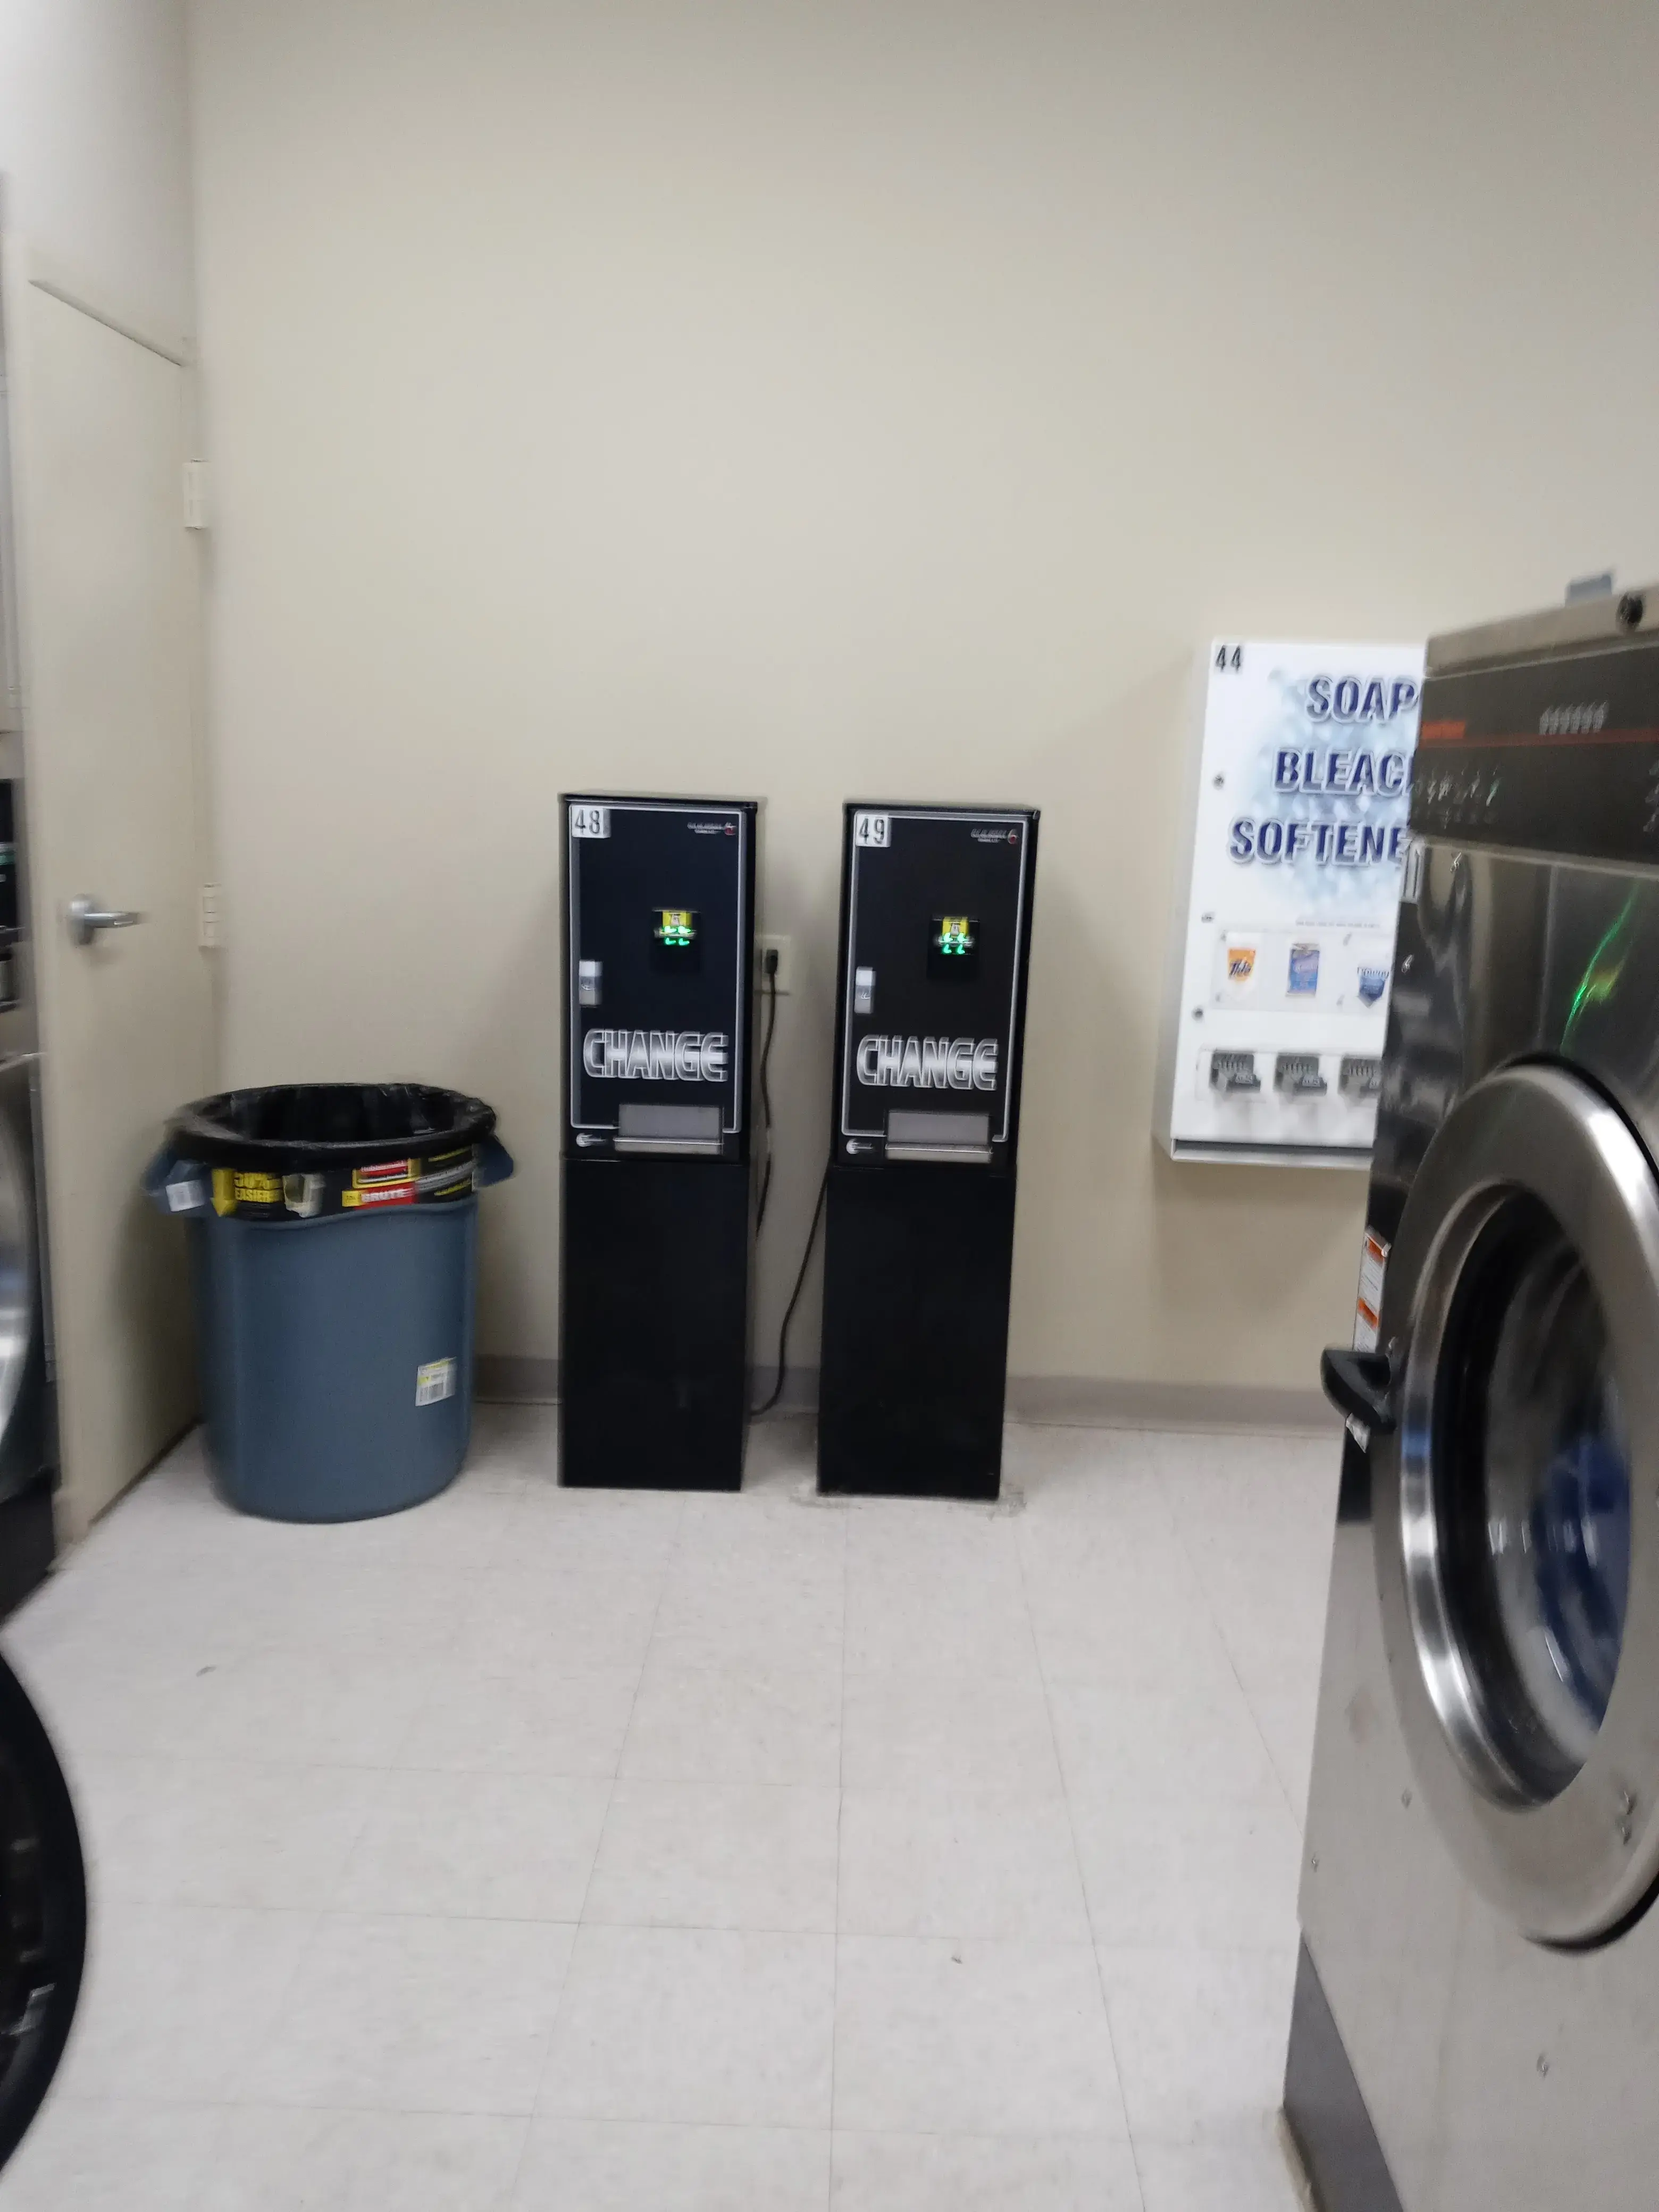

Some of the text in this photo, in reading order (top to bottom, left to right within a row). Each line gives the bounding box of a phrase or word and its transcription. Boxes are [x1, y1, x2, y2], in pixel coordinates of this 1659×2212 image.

[1215, 644, 1242, 672] 44
[1305, 675, 1419, 724] SOAP
[1274, 747, 1414, 798] BLEAC
[574, 809, 601, 834] 48
[858, 818, 885, 844] 49
[583, 1028, 729, 1082] CHANGE
[857, 1035, 998, 1091] CHANGE
